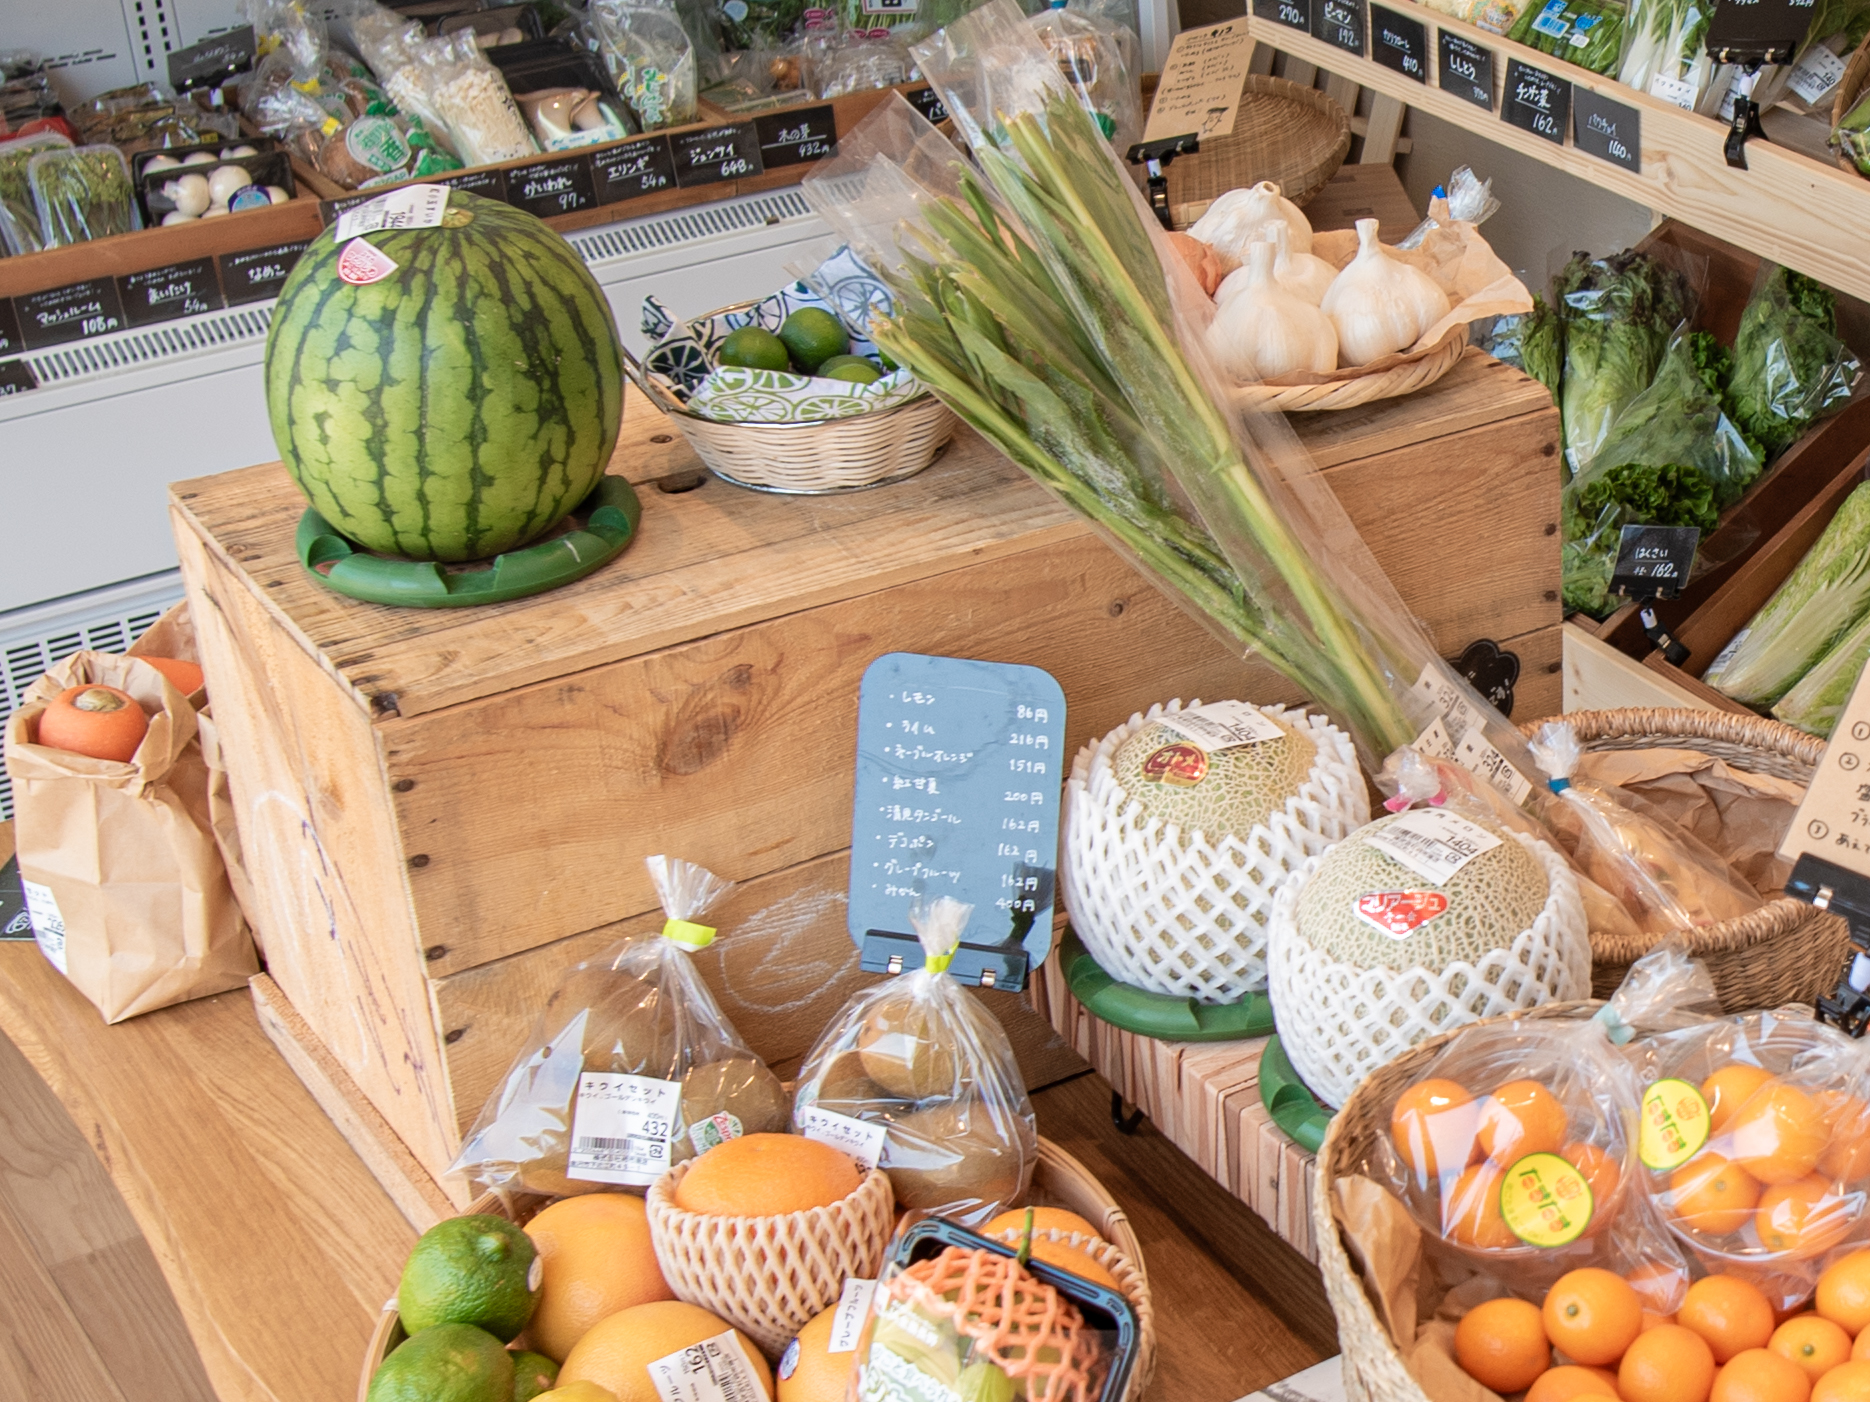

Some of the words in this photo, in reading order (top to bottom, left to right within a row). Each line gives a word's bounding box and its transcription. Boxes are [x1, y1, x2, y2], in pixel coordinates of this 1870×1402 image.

[608, 156, 650, 178] エリンギ
[524, 178, 573, 196] かいわれ
[248, 264, 285, 282] なめこ
[82, 317, 118, 336] 108円
[1634, 547, 1668, 559] はくさい
[902, 691, 936, 705] レモン
[1016, 705, 1049, 724] 86円
[901, 720, 935, 734] ライム
[1008, 733, 1049, 750] 216円
[1230, 723, 1256, 741] 1404
[894, 744, 974, 763] ネーブルオレンジ
[1009, 759, 1047, 775] 151円
[1157, 750, 1197, 767] オトメ
[892, 777, 940, 794] 紅甘夏
[1004, 791, 1043, 805] 200円
[886, 805, 962, 824] 清見タンゴール
[1002, 818, 1040, 833] 162円
[888, 832, 935, 849] デコポン
[1446, 835, 1478, 854] 1404
[884, 858, 961, 884] グレープフルーツ
[1001, 874, 1038, 891] 162円
[885, 884, 921, 897] みかん
[995, 897, 1035, 912] 400円
[585, 1081, 666, 1097] キウイセット
[642, 1120, 668, 1137] 432
[810, 1116, 873, 1140] キウイセット
[685, 1346, 705, 1376] 162
